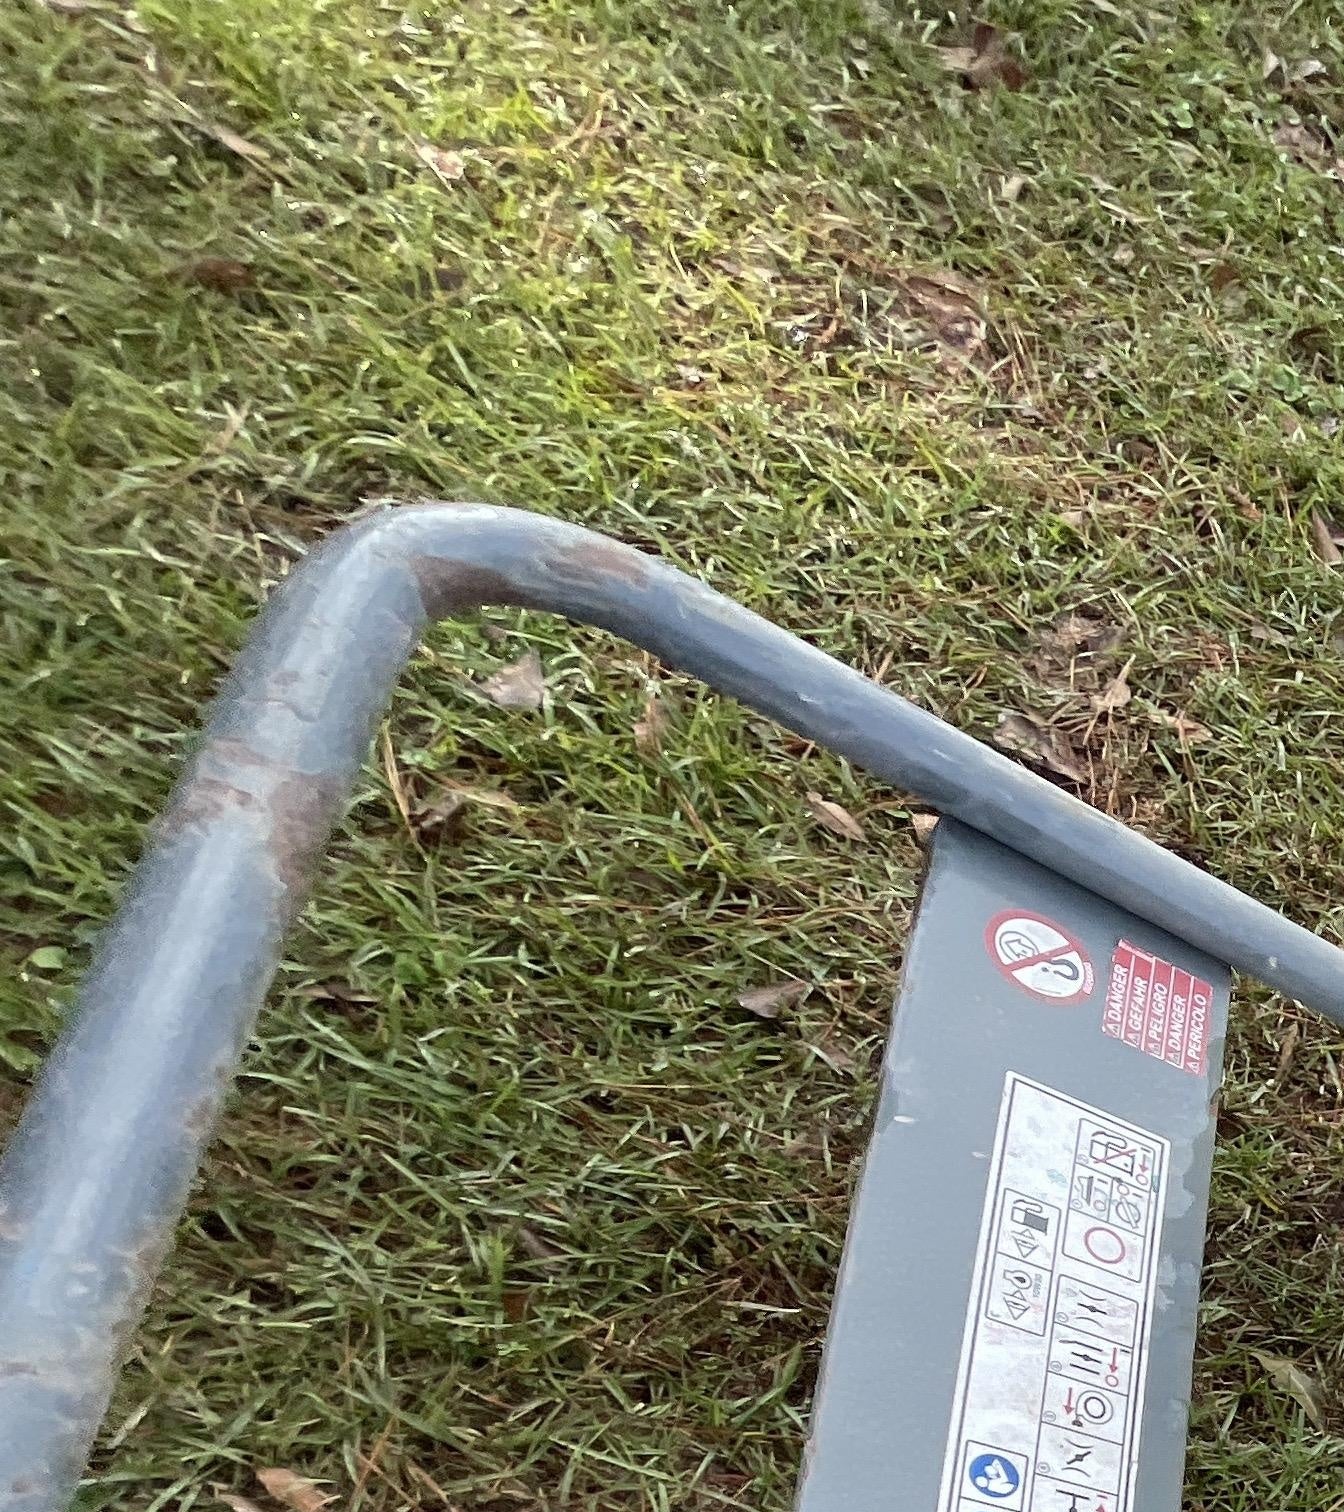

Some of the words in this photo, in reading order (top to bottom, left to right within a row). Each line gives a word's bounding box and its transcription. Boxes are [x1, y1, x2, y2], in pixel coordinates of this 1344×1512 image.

[1109, 964, 1129, 1022] DANGER
[1129, 976, 1149, 1032] GEFAHR
[1149, 984, 1168, 1042] PELIGRO
[1167, 994, 1187, 1052] DANGER
[1187, 993, 1207, 1060] PERICOLO
